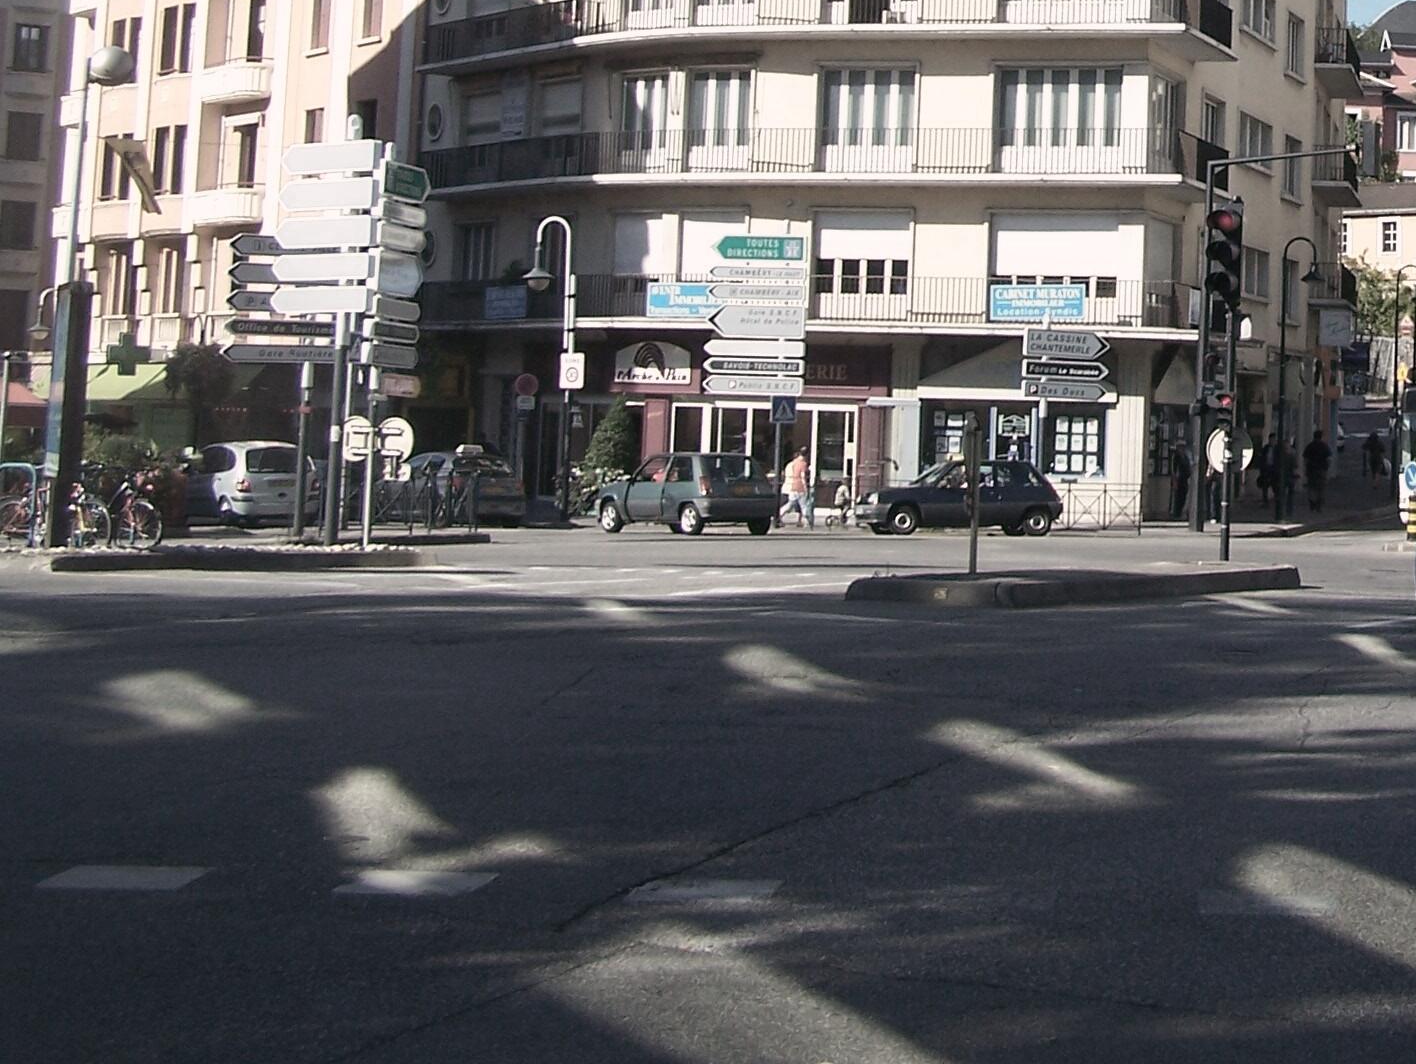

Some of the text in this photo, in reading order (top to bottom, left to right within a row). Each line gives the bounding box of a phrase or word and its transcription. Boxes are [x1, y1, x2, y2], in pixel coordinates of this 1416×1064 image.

[746, 238, 780, 248] TOUTES
[727, 248, 779, 258] DIRECTIONS
[238, 322, 268, 333] Office
[273, 323, 286, 333] de
[1031, 333, 1088, 344] LA CASSINE
[259, 348, 284, 358] Gare
[1031, 343, 1091, 354] CHANTEMERLE
[722, 362, 798, 371] SAVOIE-TECHNOLAC
[1028, 364, 1058, 374] Forum
[1041, 386, 1057, 395] Des
